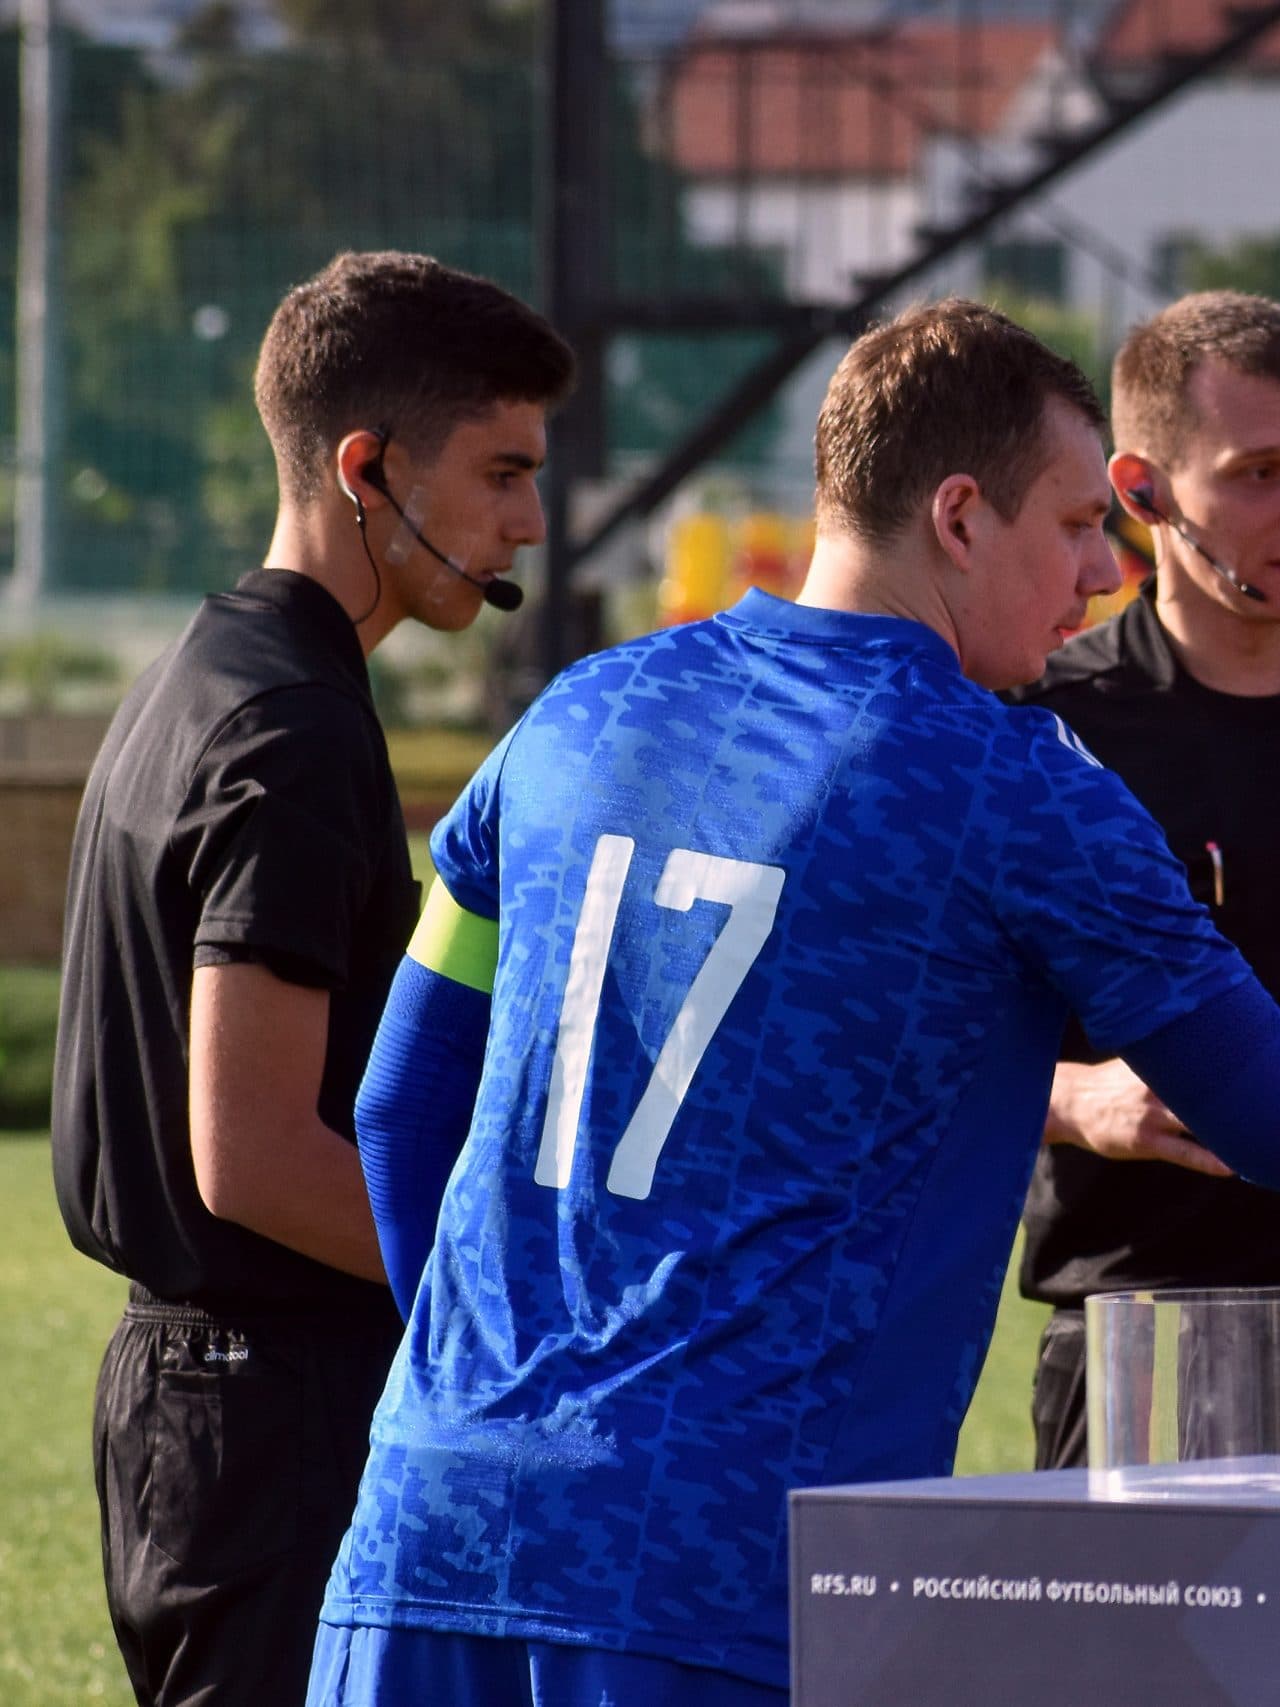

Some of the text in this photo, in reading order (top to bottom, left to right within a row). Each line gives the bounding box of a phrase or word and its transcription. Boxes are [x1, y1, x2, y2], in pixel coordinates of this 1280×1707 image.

[534, 834, 786, 1200] 17
[811, 1574, 876, 1596] RFS.RU
[913, 1576, 1042, 1602] РОССИЙСКИЙ
[1046, 1579, 1179, 1605] ФУТБОЛЬНЫЙ
[1184, 1585, 1242, 1607] СОЮЗ
